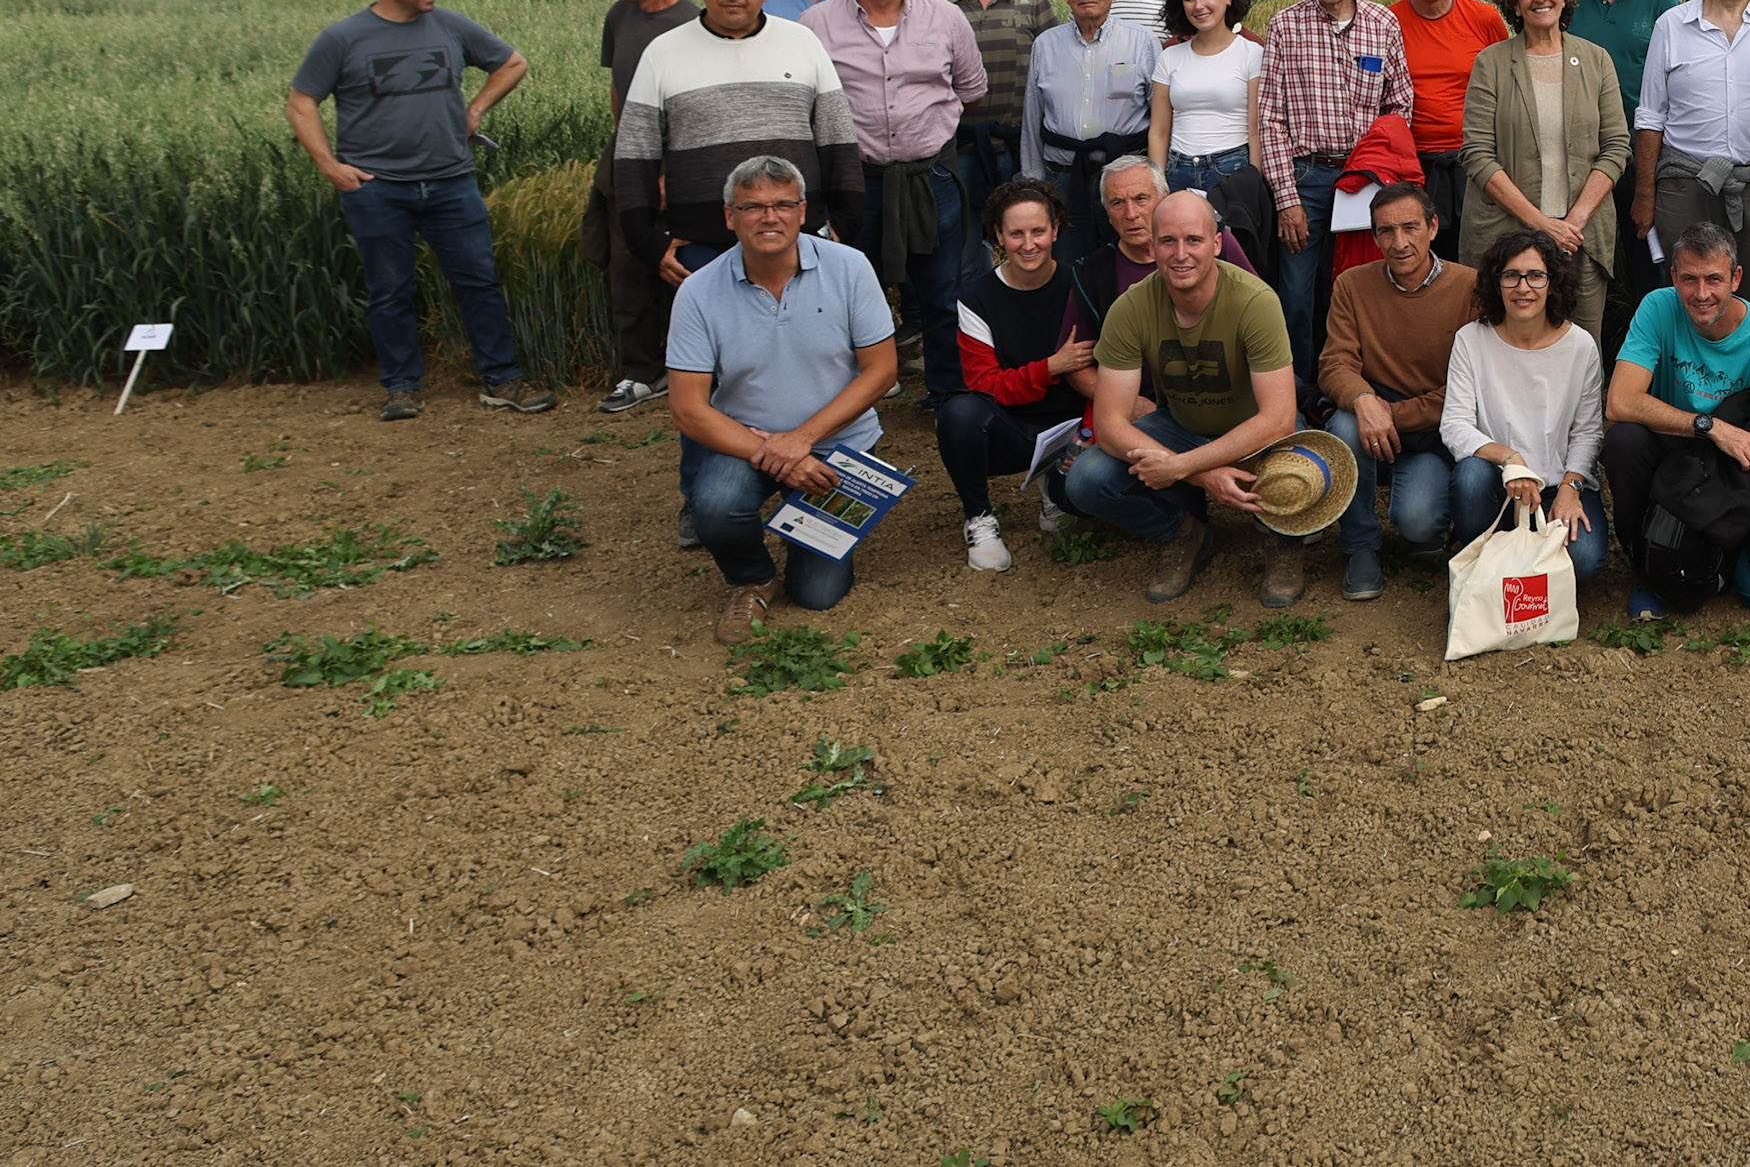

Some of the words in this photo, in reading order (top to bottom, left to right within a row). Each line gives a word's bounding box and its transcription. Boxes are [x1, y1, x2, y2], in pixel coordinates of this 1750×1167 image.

[1198, 395, 1234, 407] JONES
[858, 469, 894, 490] INTIA
[1514, 597, 1548, 611] Gourmet
[1522, 594, 1544, 605] Reyno
[1506, 615, 1550, 629] CALIDAD
[1506, 620, 1549, 636] NAVARRA
